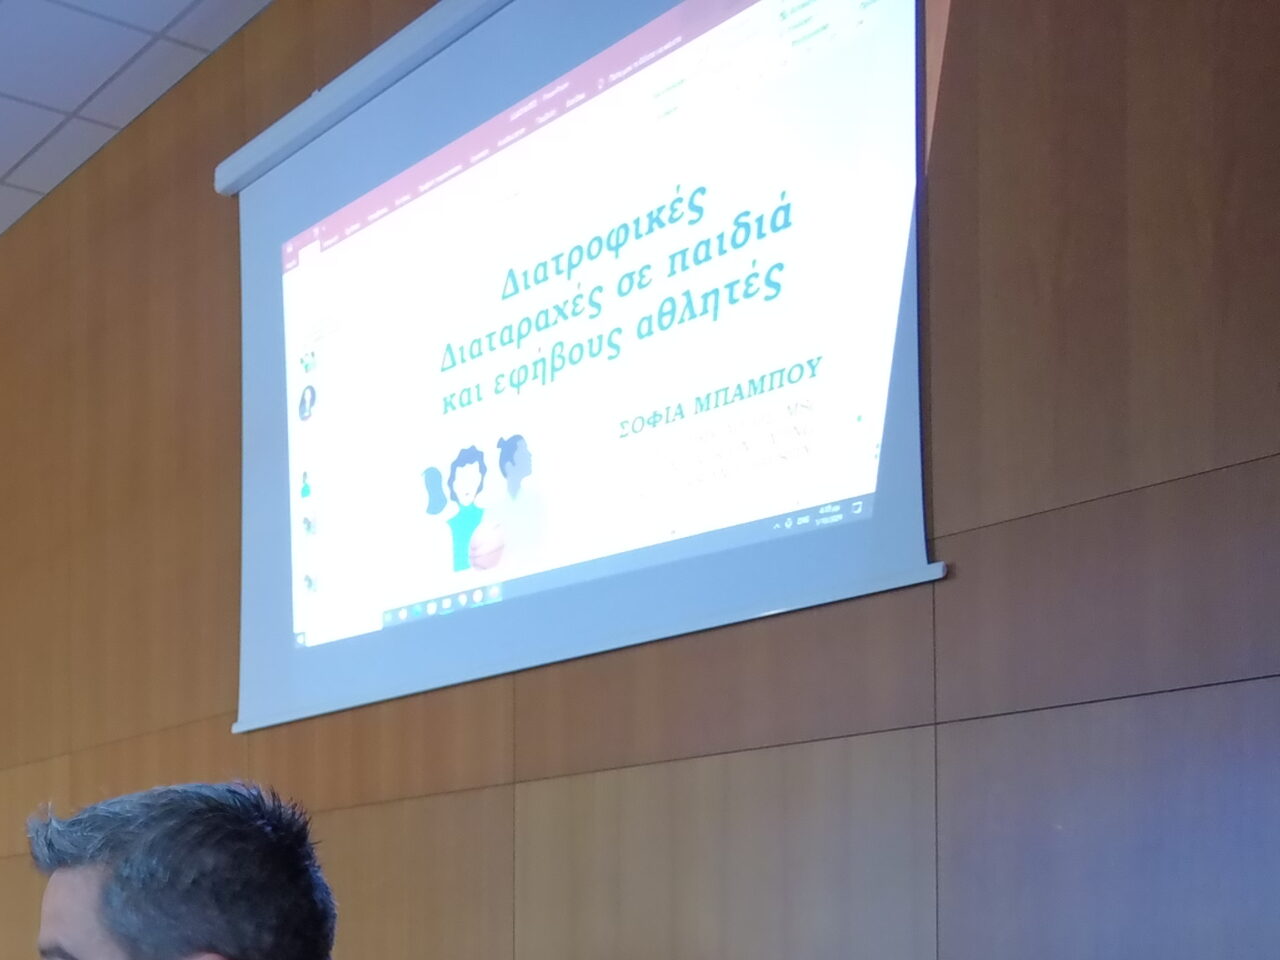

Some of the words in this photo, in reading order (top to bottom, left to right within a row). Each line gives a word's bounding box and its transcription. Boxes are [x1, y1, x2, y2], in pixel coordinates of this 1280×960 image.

[440, 283, 604, 373] Διαταραχές
[616, 264, 653, 298] σε
[666, 191, 794, 278] παιδιά
[501, 184, 707, 301] Διατροφικές
[442, 383, 484, 415] και
[493, 327, 623, 395] εφήβους
[636, 259, 785, 340] αθλητές
[619, 403, 686, 439] ΣΟΦΙΑ
[694, 356, 823, 415] ΜΠΑΜΠΟΥ
